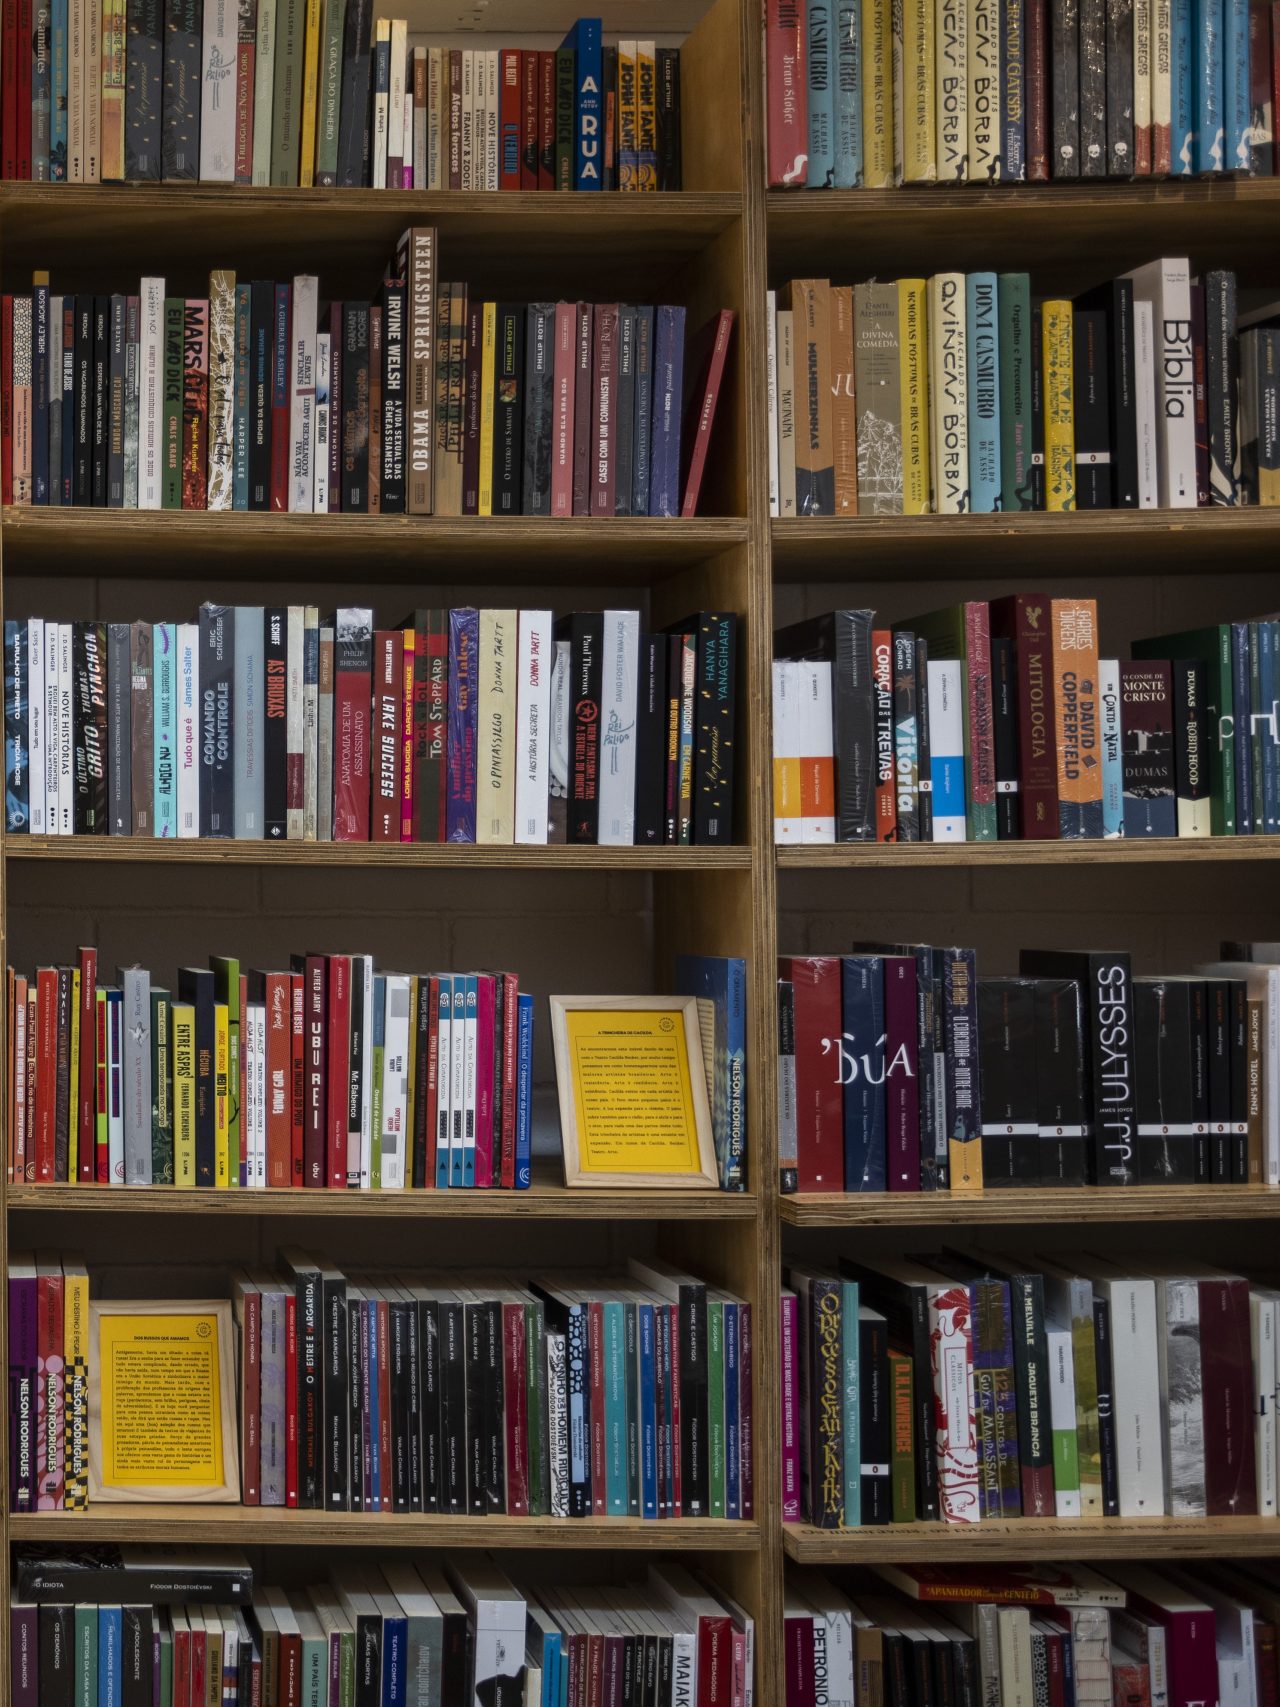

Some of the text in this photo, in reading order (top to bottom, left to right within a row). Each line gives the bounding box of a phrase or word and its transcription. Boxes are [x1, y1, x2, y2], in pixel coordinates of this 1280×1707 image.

[809, 7, 827, 90] CASMURRO
[241, 110, 246, 119] DE
[581, 77, 597, 92] A
[1007, 63, 1021, 124] GATSBY
[168, 309, 181, 326] EU
[414, 236, 431, 358] SPRINGSTEEN
[184, 307, 203, 368] MARS
[387, 296, 401, 389] IRVINE WELSH
[975, 284, 994, 418] DOM CASMURRO
[167, 370, 181, 401] DICK
[808, 343, 819, 449] MULHERZINHAS
[1163, 320, 1193, 418] Bíblia
[413, 410, 428, 470] OBAMA
[599, 377, 609, 483] CASEI COM UM COMUNISTA
[85, 633, 104, 706] PYNCHON
[183, 647, 192, 708] James Salter
[706, 640, 715, 681] HANYA
[718, 621, 728, 700] YANAGIHARA
[1124, 682, 1164, 691] MONTE
[79, 671, 90, 713] THOMAS
[1029, 654, 1045, 758] MITOLOGIA
[1124, 693, 1165, 702] CRISTO
[84, 726, 103, 778] GRITO
[342, 702, 351, 785] ANATOMIA DE UM
[355, 712, 363, 776] ASSASSINATO
[381, 696, 394, 797] LAKE SUCCESS
[877, 719, 892, 780] TREVAS
[1063, 672, 1078, 779] COPPERFIELD
[1081, 701, 1094, 748] DAVID
[76, 747, 86, 783] ÚLTIMO
[1098, 966, 1129, 1101] ULYSSES
[272, 1070, 283, 1114] FUNNY GIRL
[732, 1098, 740, 1155] RODRIGUES
[306, 1283, 314, 1333] MARGARIDA
[1026, 1298, 1034, 1344] MELVILLE
[306, 1344, 314, 1372] MESTRE
[20, 1378, 29, 1477] NELSON RODRIGUES
[1028, 1363, 1039, 1457] JAQUETA BRANCA
[54, 1623, 60, 1632] OS
[814, 1628, 826, 1705] PETRONIO
